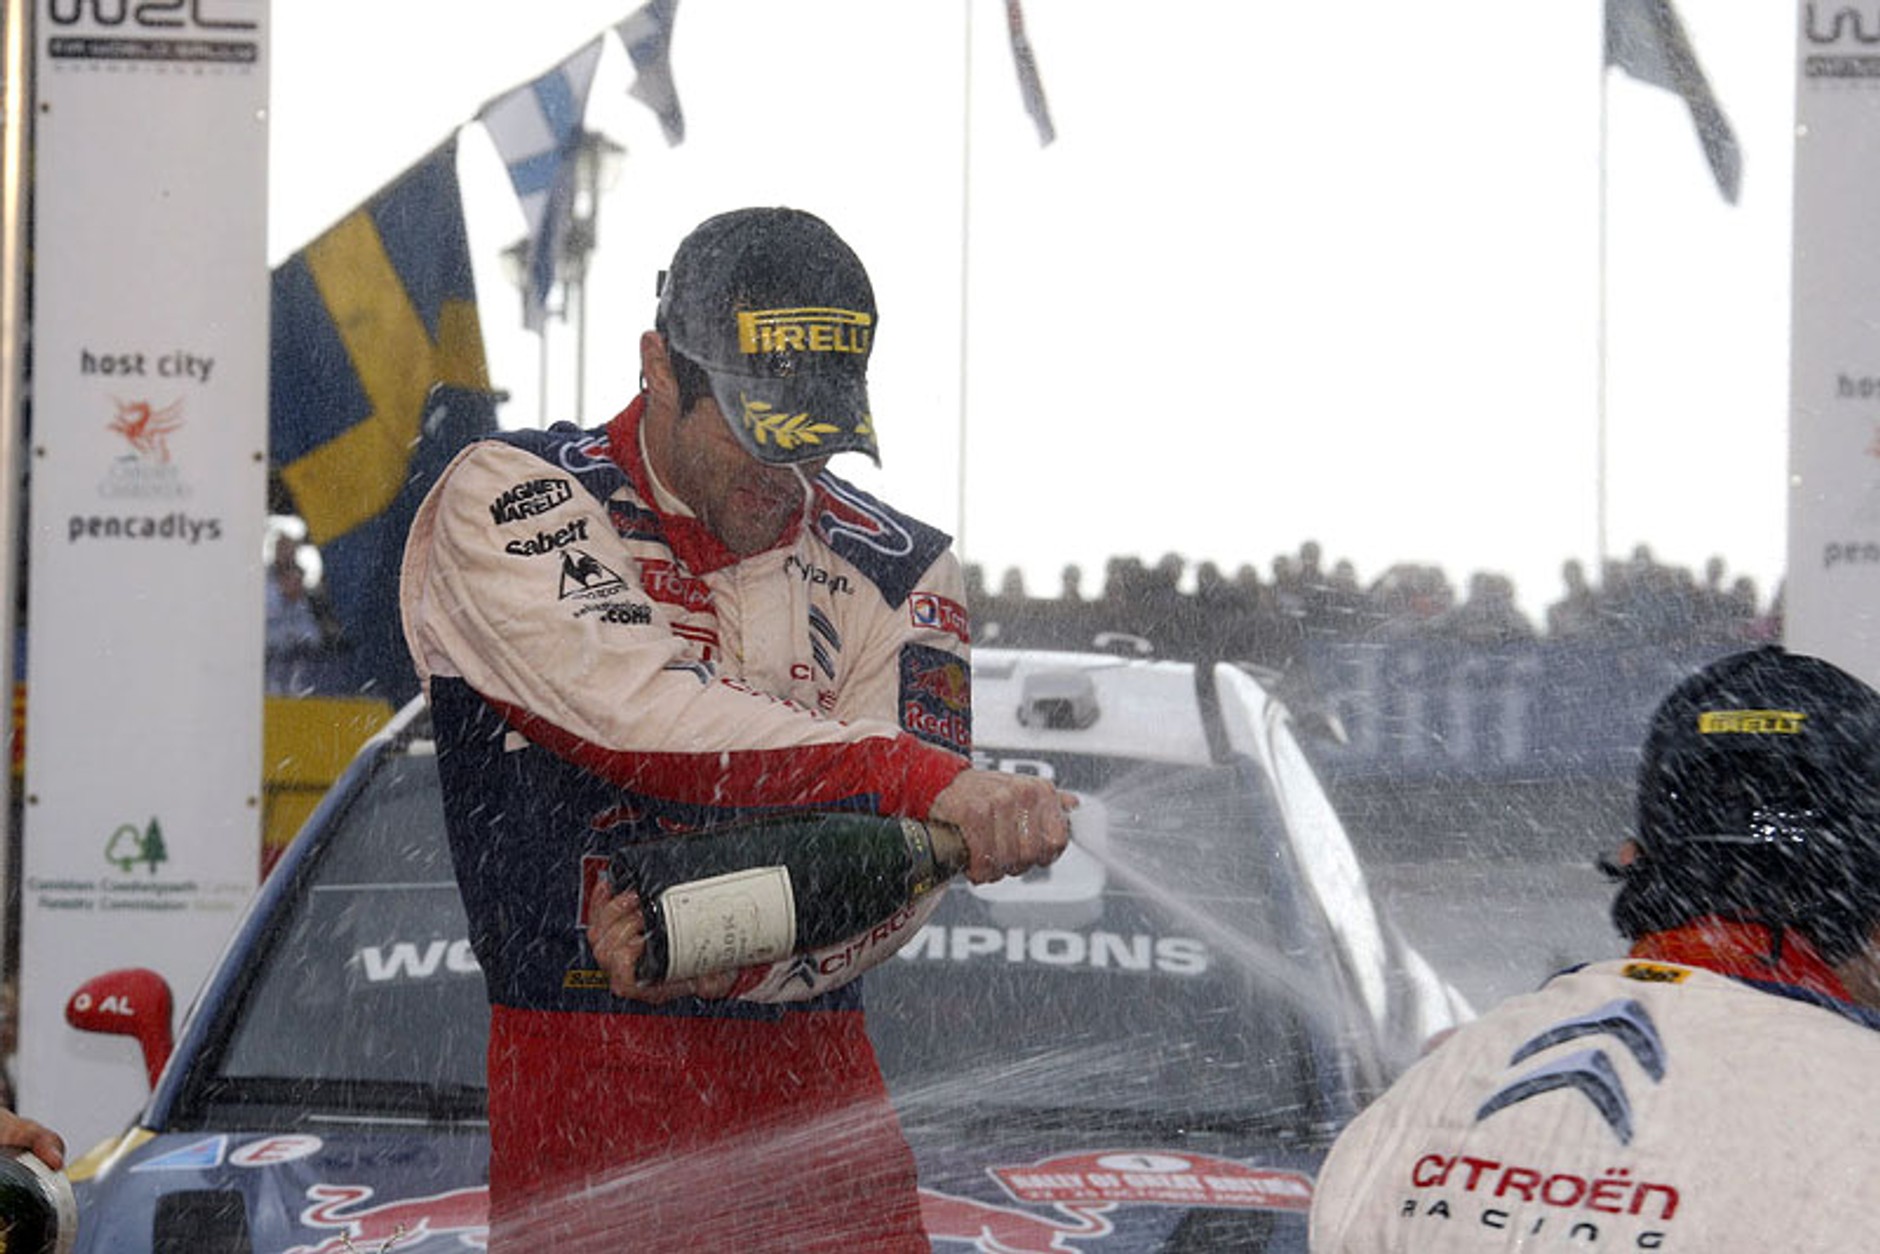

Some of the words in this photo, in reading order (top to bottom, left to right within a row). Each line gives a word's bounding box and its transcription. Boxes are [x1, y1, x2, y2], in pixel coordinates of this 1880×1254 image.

[737, 307, 873, 354] PIRELLI
[80, 349, 145, 376] host
[157, 350, 215, 382] city
[68, 513, 222, 544] pencadlys
[904, 701, 951, 739] Red
